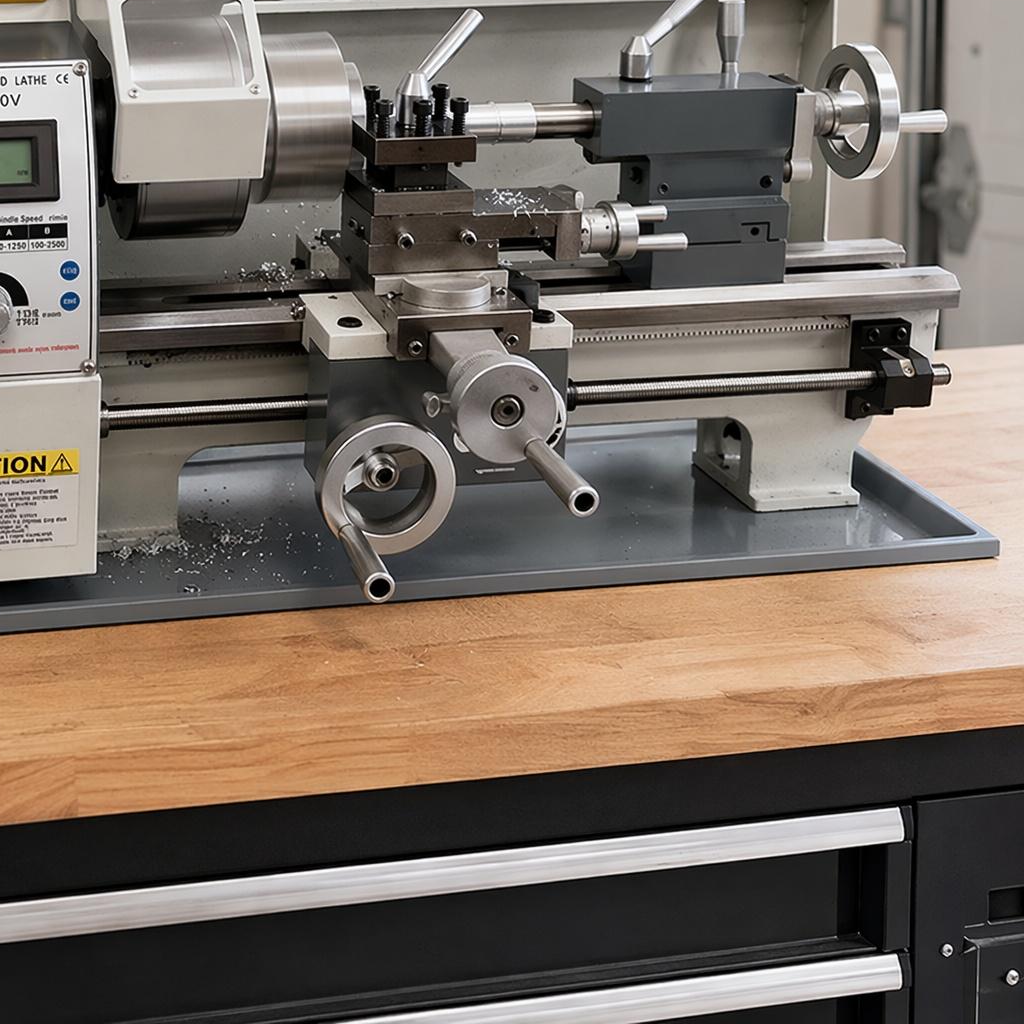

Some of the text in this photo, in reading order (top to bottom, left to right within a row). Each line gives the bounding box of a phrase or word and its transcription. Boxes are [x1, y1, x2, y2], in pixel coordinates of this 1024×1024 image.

[15, 75, 47, 86] LATHE
[20, 214, 43, 223] Speed
[6, 228, 13, 236] A
[31, 240, 66, 249] 100-2500
